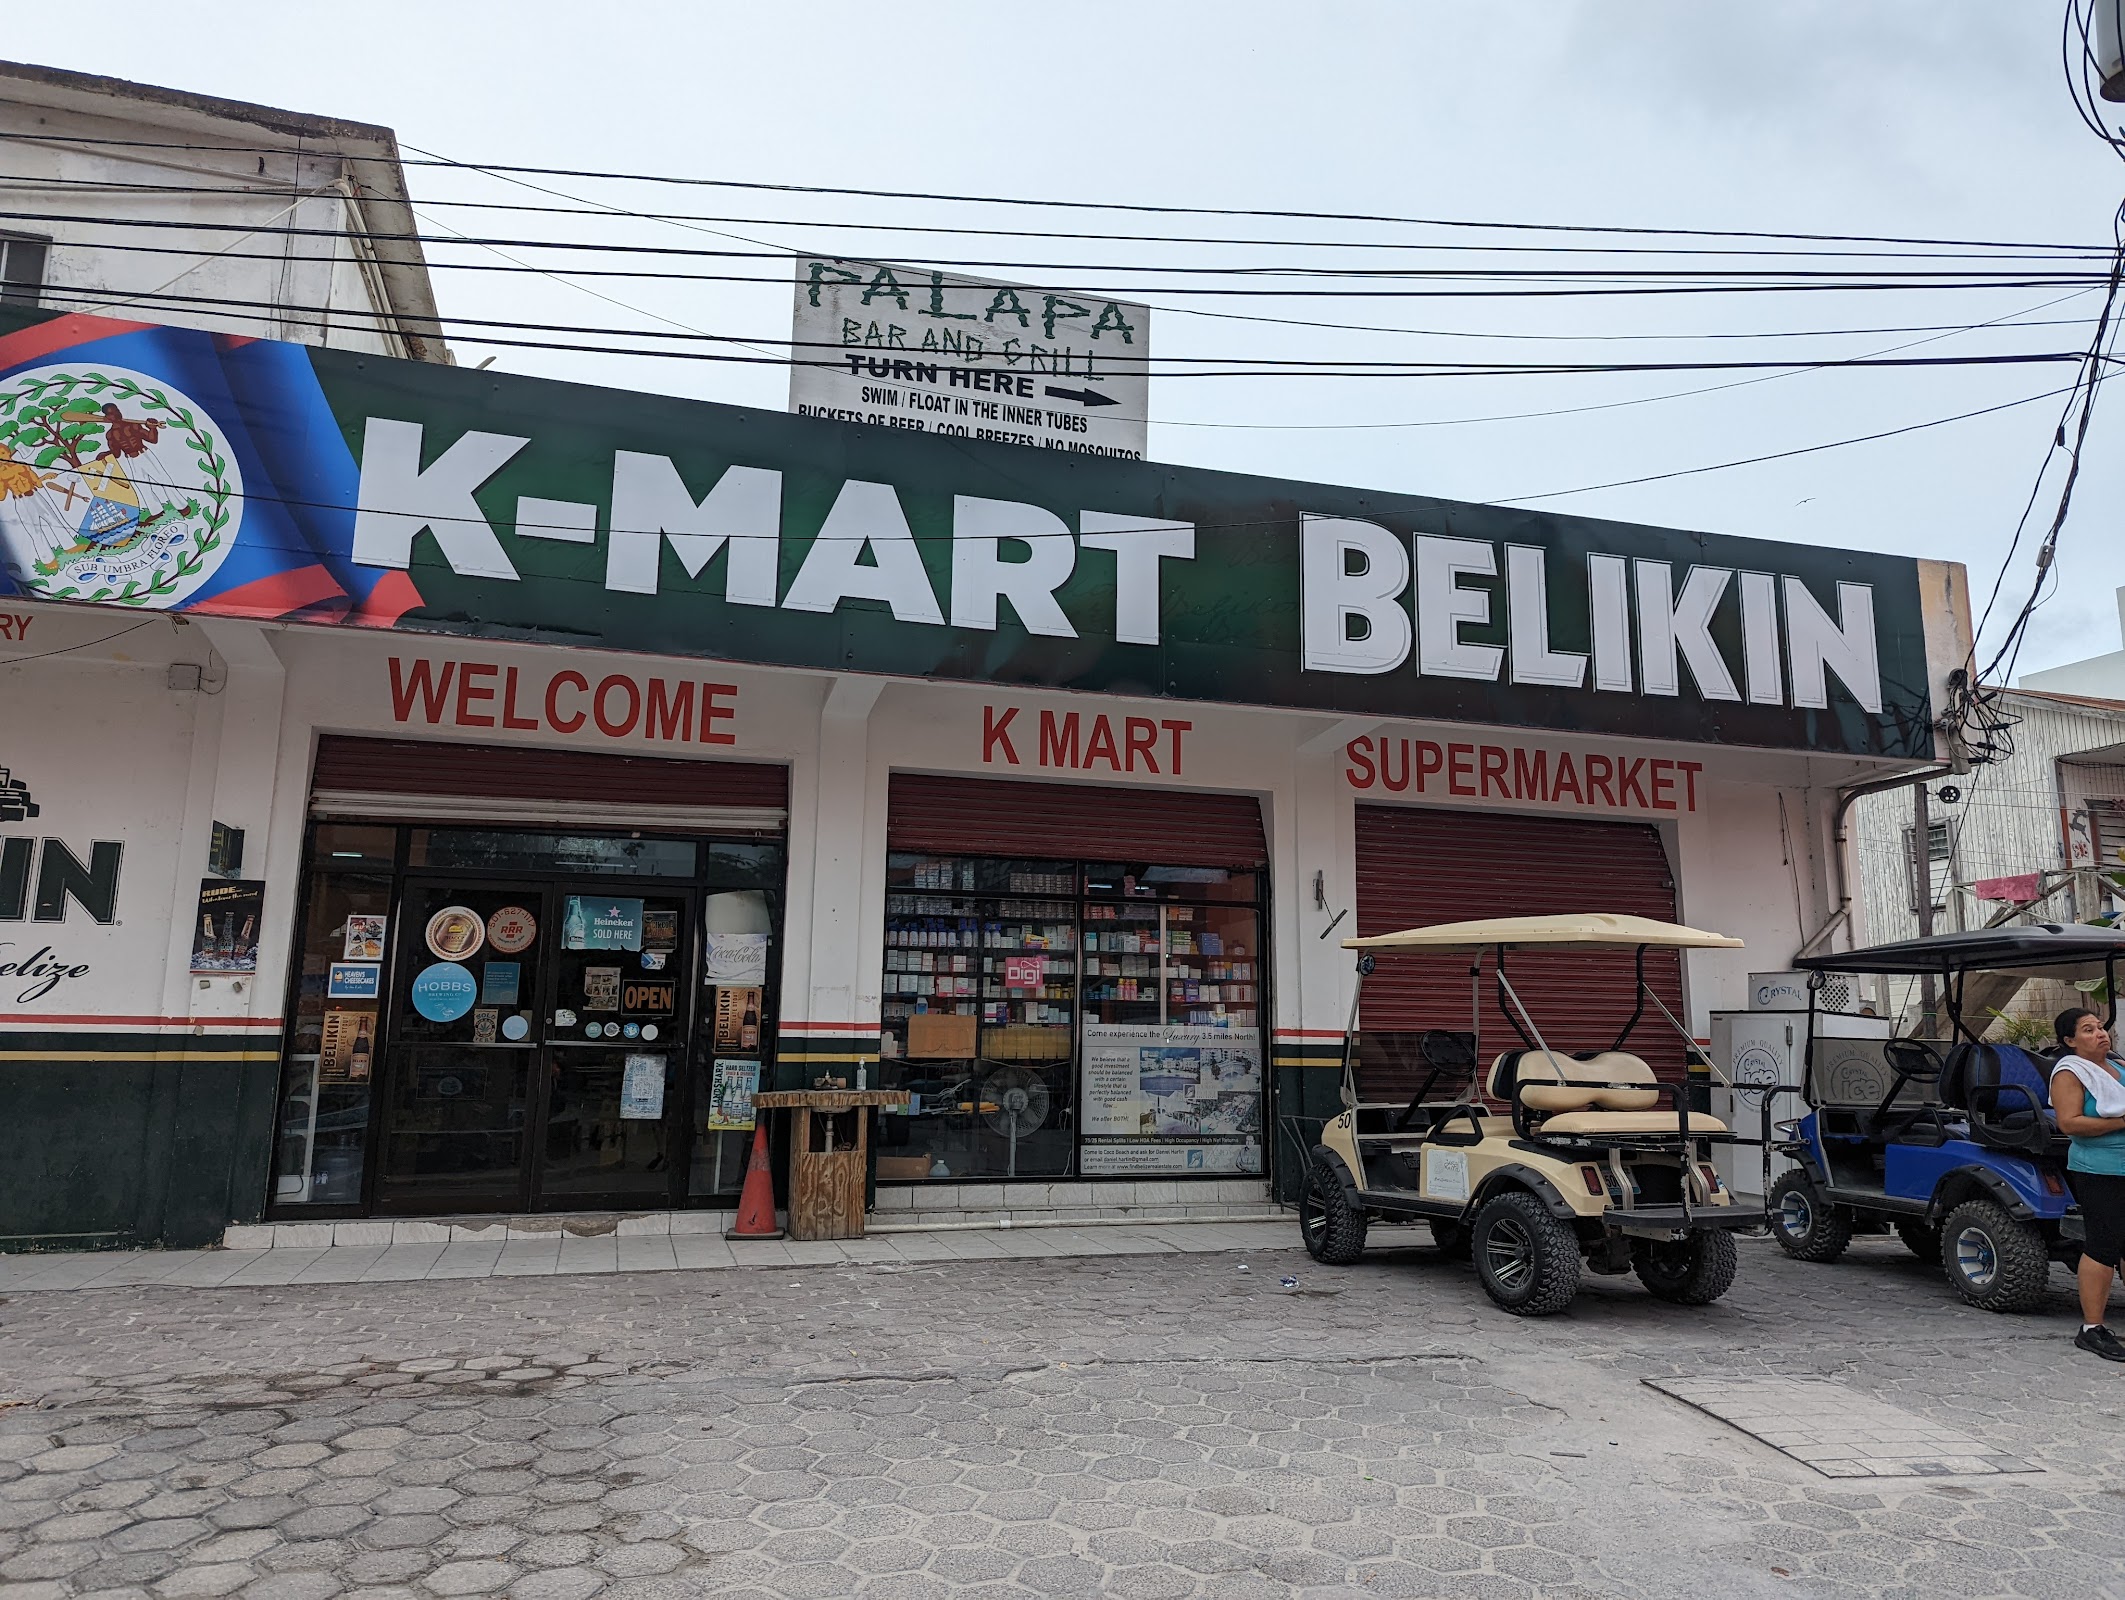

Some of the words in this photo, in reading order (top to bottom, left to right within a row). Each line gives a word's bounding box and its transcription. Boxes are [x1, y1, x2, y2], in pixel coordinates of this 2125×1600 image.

[807, 262, 1135, 344] PALAPA
[842, 318, 906, 348] BAR
[921, 327, 983, 363] AND
[1003, 337, 1104, 380] GRILL
[845, 353, 937, 384] TURN
[950, 367, 1034, 398] HERE
[862, 386, 897, 407] SWIM
[909, 392, 951, 413] FLOAT
[955, 398, 968, 416] IN
[973, 401, 998, 420] THE
[1002, 406, 1042, 426] INNER
[1046, 412, 1088, 433] TUBES
[798, 404, 863, 423] BUCKETS
[868, 413, 885, 425] OF
[890, 416, 924, 431] BEER
[937, 423, 971, 438] COOL
[976, 428, 1034, 447] BREEZES
[1045, 438, 1064, 450] NO
[1068, 441, 1141, 461] MOSQUITOS
[74, 563, 98, 574] SUB
[103, 559, 148, 574] UMBRA
[146, 525, 179, 560] FLOREO
[351, 416, 1195, 646] K-MART
[1299, 510, 1883, 714] BELIKIN
[0, 614, 34, 640] RY
[387, 656, 739, 745] WELCOME
[982, 706, 1020, 765] K
[1037, 711, 1193, 777] MART
[1345, 735, 1702, 812] SUPERMARKET
[500, 926, 523, 934] RRR
[593, 929, 612, 939] SOLD
[614, 930, 632, 940] HERE
[594, 918, 634, 927] Heineken
[0, 942, 90, 1003] elize
[709, 946, 762, 963] Coca-Cola
[1008, 965, 1040, 984] Digi
[418, 982, 472, 992] HOBBS
[624, 986, 672, 1009] OPEN
[1758, 986, 1802, 1005] CRYSTAL
[718, 990, 731, 1038] BELIKIN
[1087, 1030, 1107, 1038] Come
[1109, 1030, 1148, 1039] experience
[1162, 1027, 1200, 1045] Luxury
[1213, 1032, 1232, 1040] miles
[1234, 1033, 1256, 1041] North!
[322, 1015, 340, 1067] BELIKIN
[1732, 1040, 1756, 1064] PREMIUM
[1760, 1040, 1784, 1064] QUALITY
[1826, 1050, 1855, 1072] PREMIUM
[711, 1062, 724, 1108] LANDSHARK
[1338, 1112, 1351, 1128] 50
